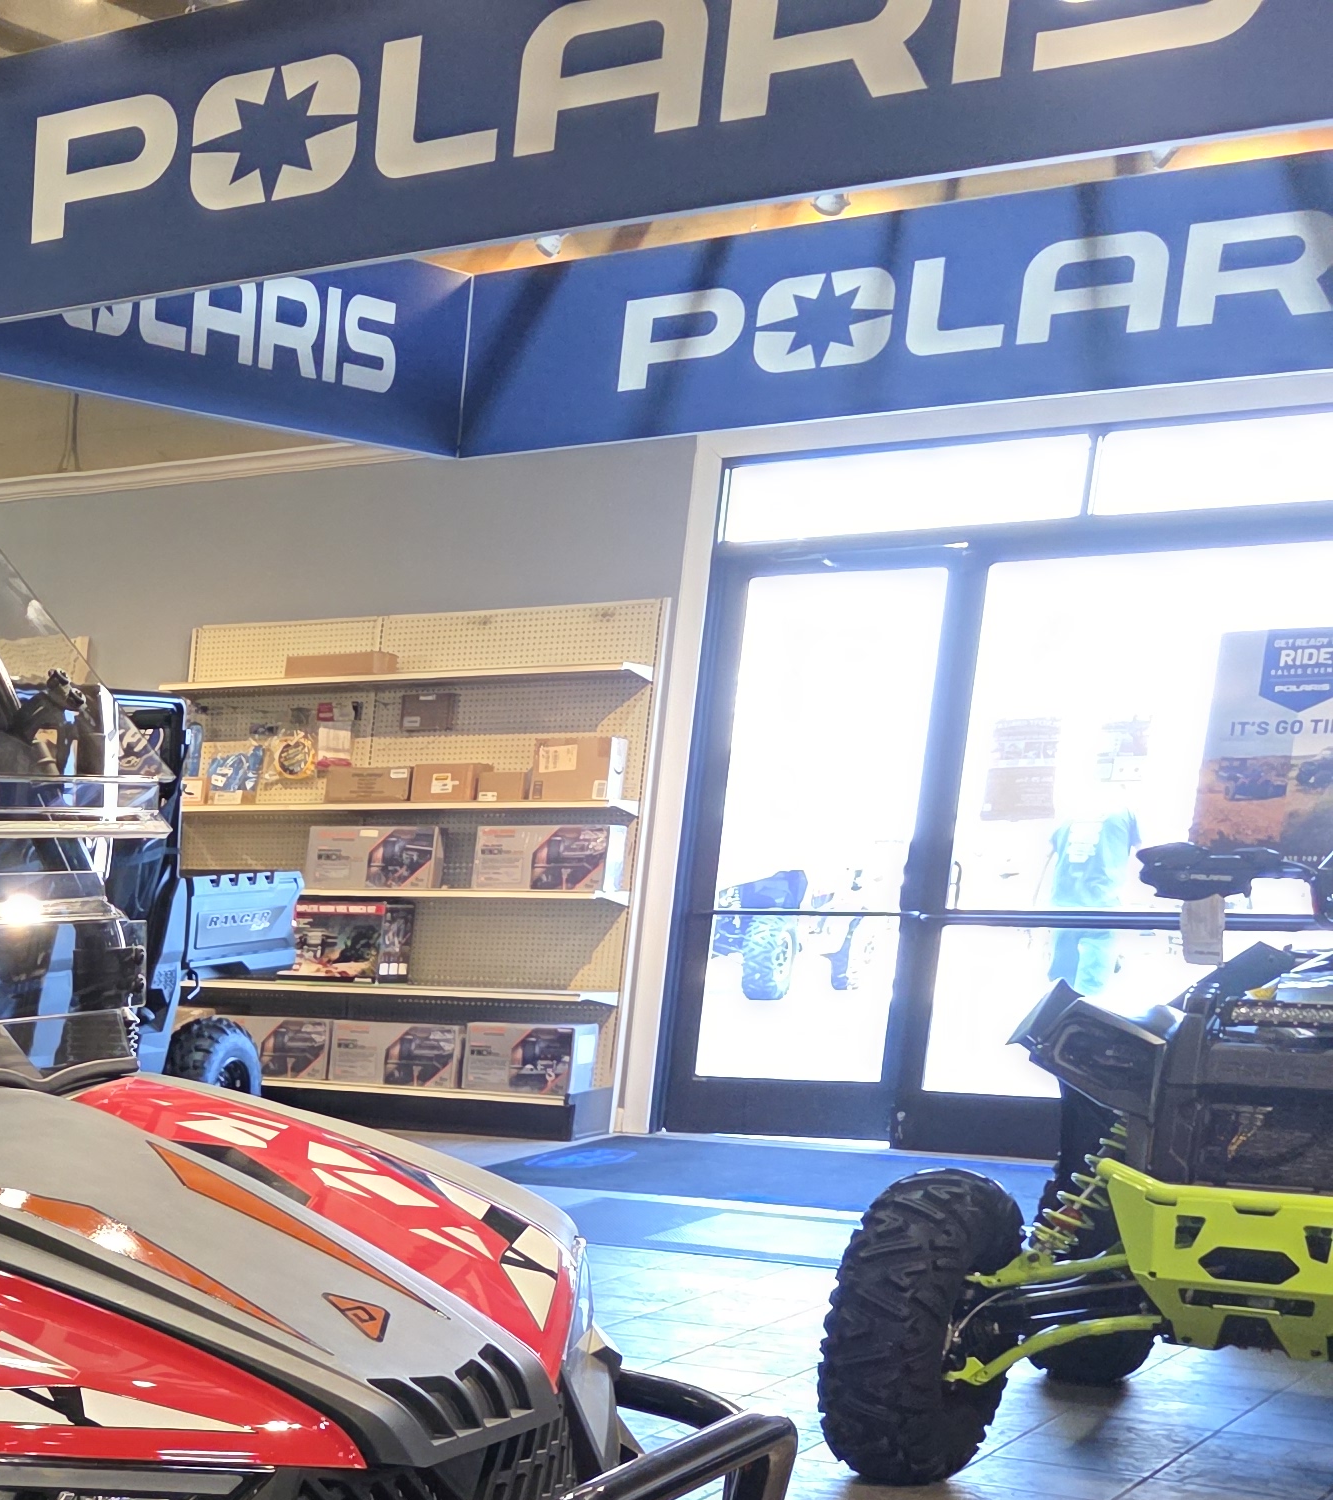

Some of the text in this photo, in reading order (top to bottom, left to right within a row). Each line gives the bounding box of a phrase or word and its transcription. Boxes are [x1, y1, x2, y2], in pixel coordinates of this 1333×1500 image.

[62, 276, 397, 394] LARIS
[1274, 637, 1329, 647] GET READY
[1279, 647, 1333, 667] RIDE
[1230, 721, 1270, 736] IT'S
[1275, 719, 1304, 735] GO
[206, 910, 272, 930] RANGER
